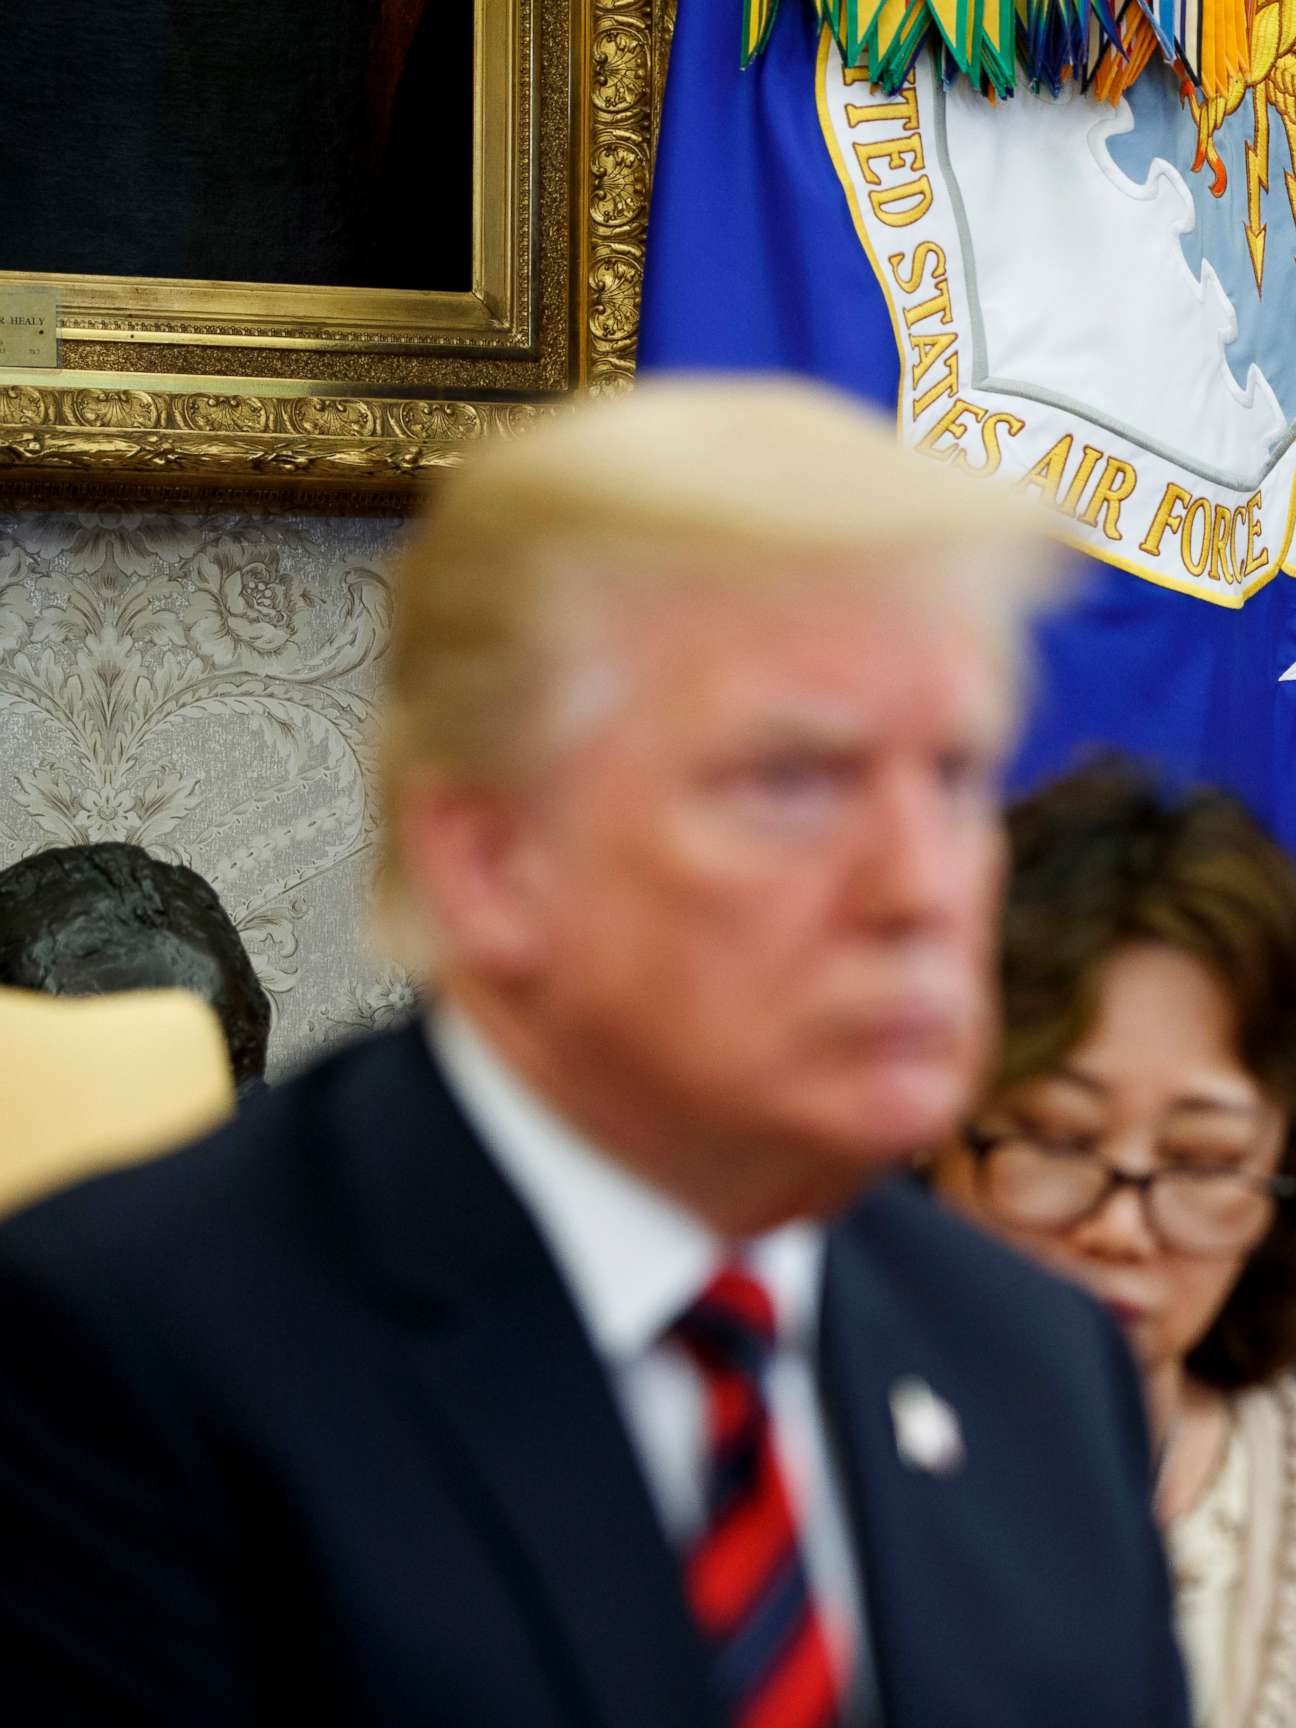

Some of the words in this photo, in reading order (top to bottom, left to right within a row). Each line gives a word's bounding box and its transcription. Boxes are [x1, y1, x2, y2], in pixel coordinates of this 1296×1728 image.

[887, 240, 1026, 478] STATES
[1015, 433, 1137, 541] AIR
[1138, 482, 1269, 585] FORCE
